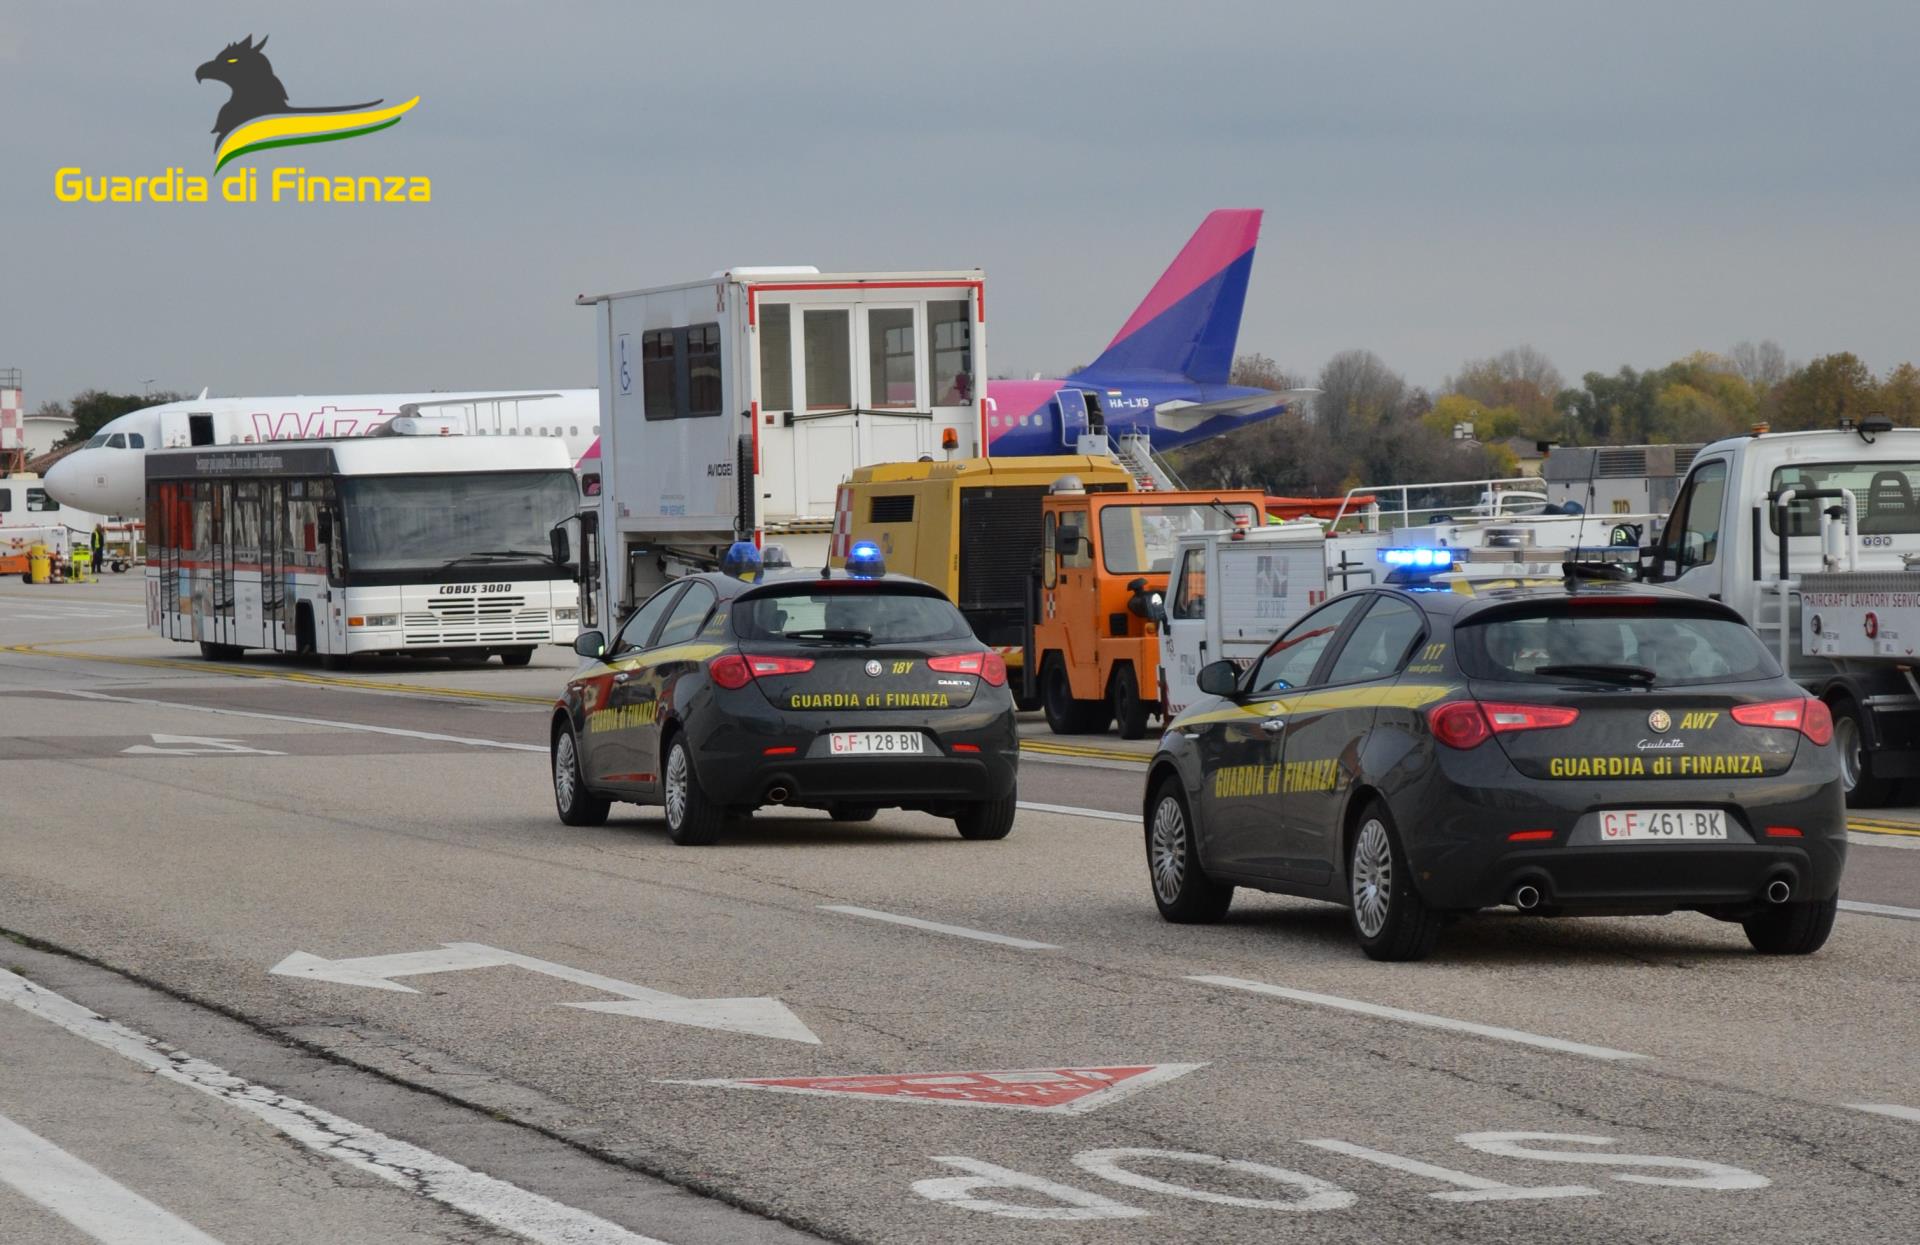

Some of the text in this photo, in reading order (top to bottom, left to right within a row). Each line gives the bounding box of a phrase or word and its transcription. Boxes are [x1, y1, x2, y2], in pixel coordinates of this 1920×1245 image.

[1109, 397, 1149, 408] HA-LXB
[440, 583, 512, 595] COBUS 3000
[1808, 593, 1848, 608] AIRCRAFT
[1851, 593, 1889, 608] LAVATORY
[1423, 643, 1446, 660] 117
[891, 661, 914, 674] 18Y
[791, 692, 949, 709] GUARDIA di FINANZA
[591, 700, 657, 734] GUARDIA di FINANZA
[1680, 712, 1719, 730] AW7
[1551, 755, 1764, 777] GUARDIA di FINANZA
[1215, 758, 1339, 798] GUARDIA di FINANZA
[911, 1131, 1772, 1222] STOP
